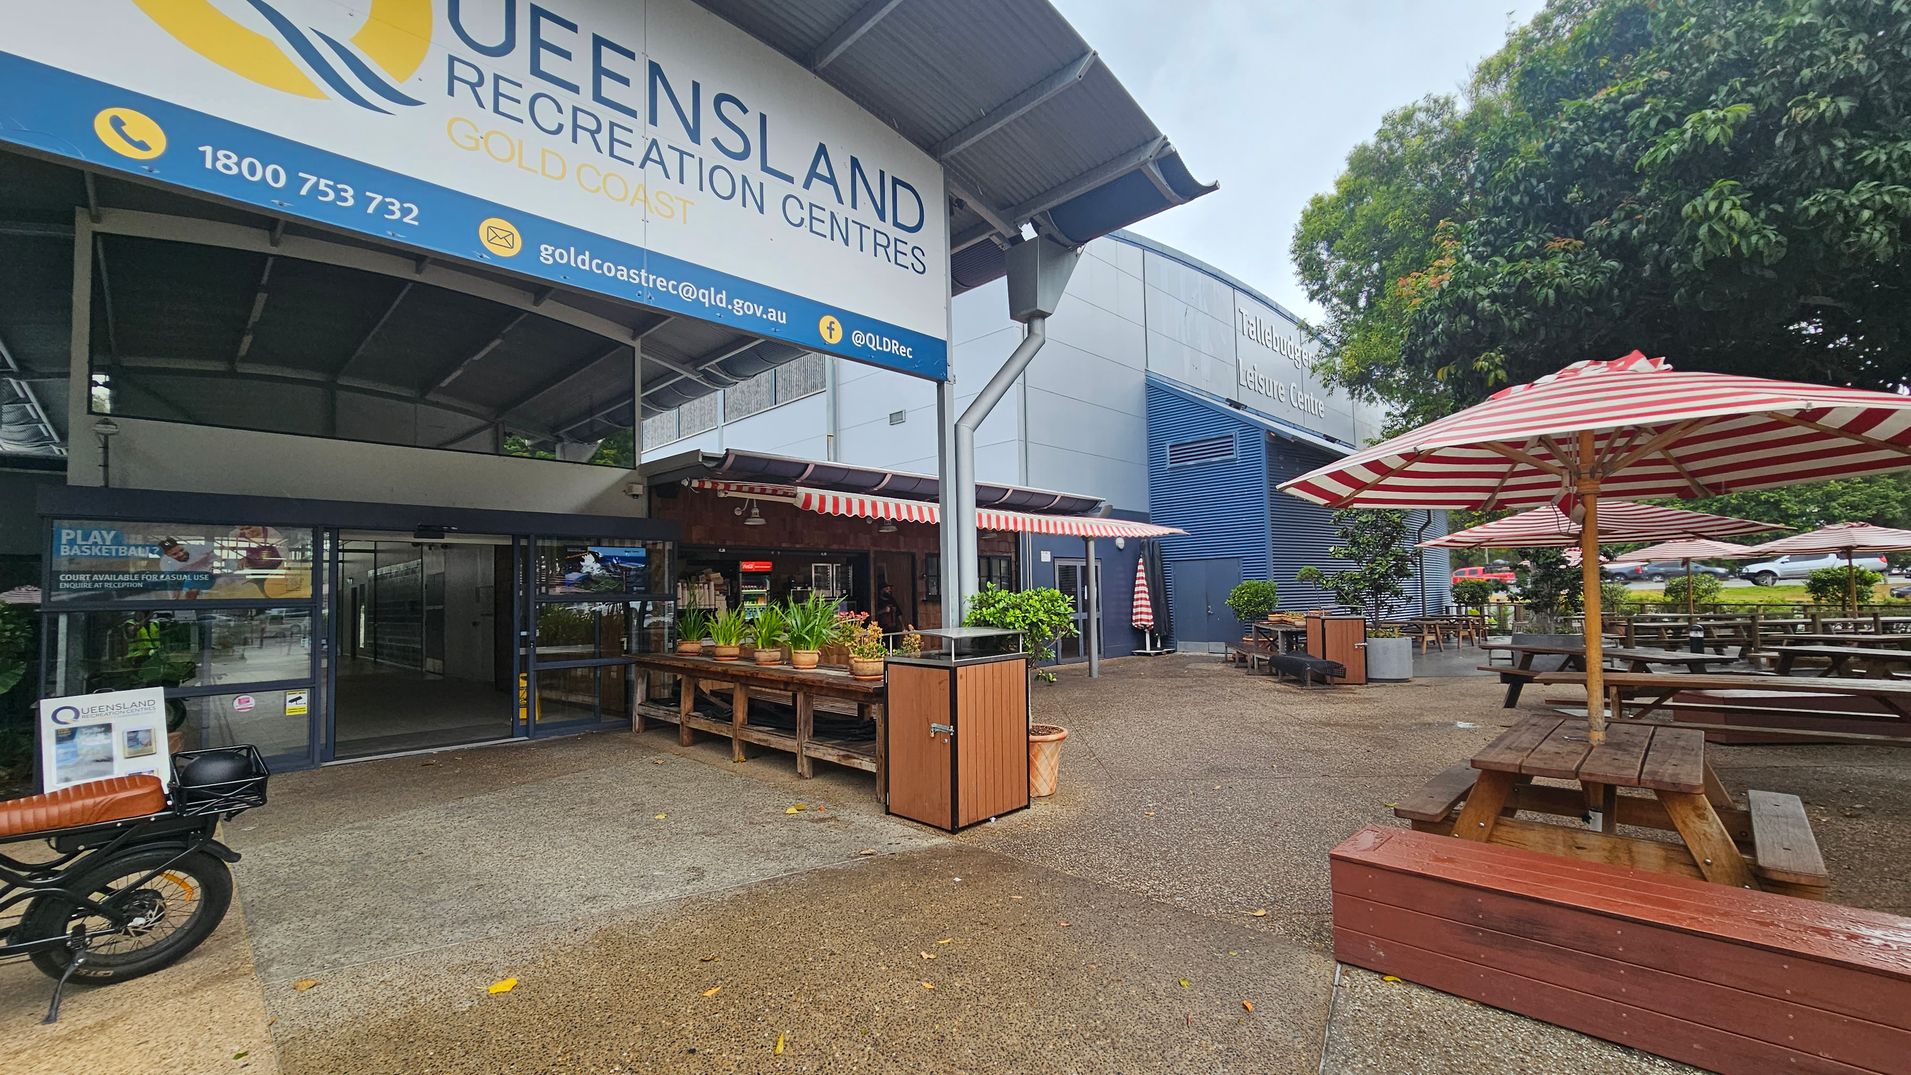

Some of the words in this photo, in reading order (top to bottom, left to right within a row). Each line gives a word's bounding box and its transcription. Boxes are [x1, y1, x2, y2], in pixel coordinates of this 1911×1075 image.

[198, 145, 287, 188] 1800
[298, 172, 354, 207] 753
[365, 191, 420, 225] 732
[446, 116, 567, 181] GOLD
[576, 163, 695, 225] COAST
[447, 53, 764, 214] RECREATION
[782, 194, 926, 275] CENTRES
[540, 241, 787, 325] goldcoastrec@qld.gov.au
[851, 329, 913, 358] @QLDRec
[1238, 306, 1314, 369] Tallebudger
[1237, 357, 1286, 403] Leisure
[1289, 382, 1325, 419] Centre
[61, 529, 116, 545] PLAY
[59, 573, 91, 581] COURT
[92, 573, 139, 581] AVAILABLE
